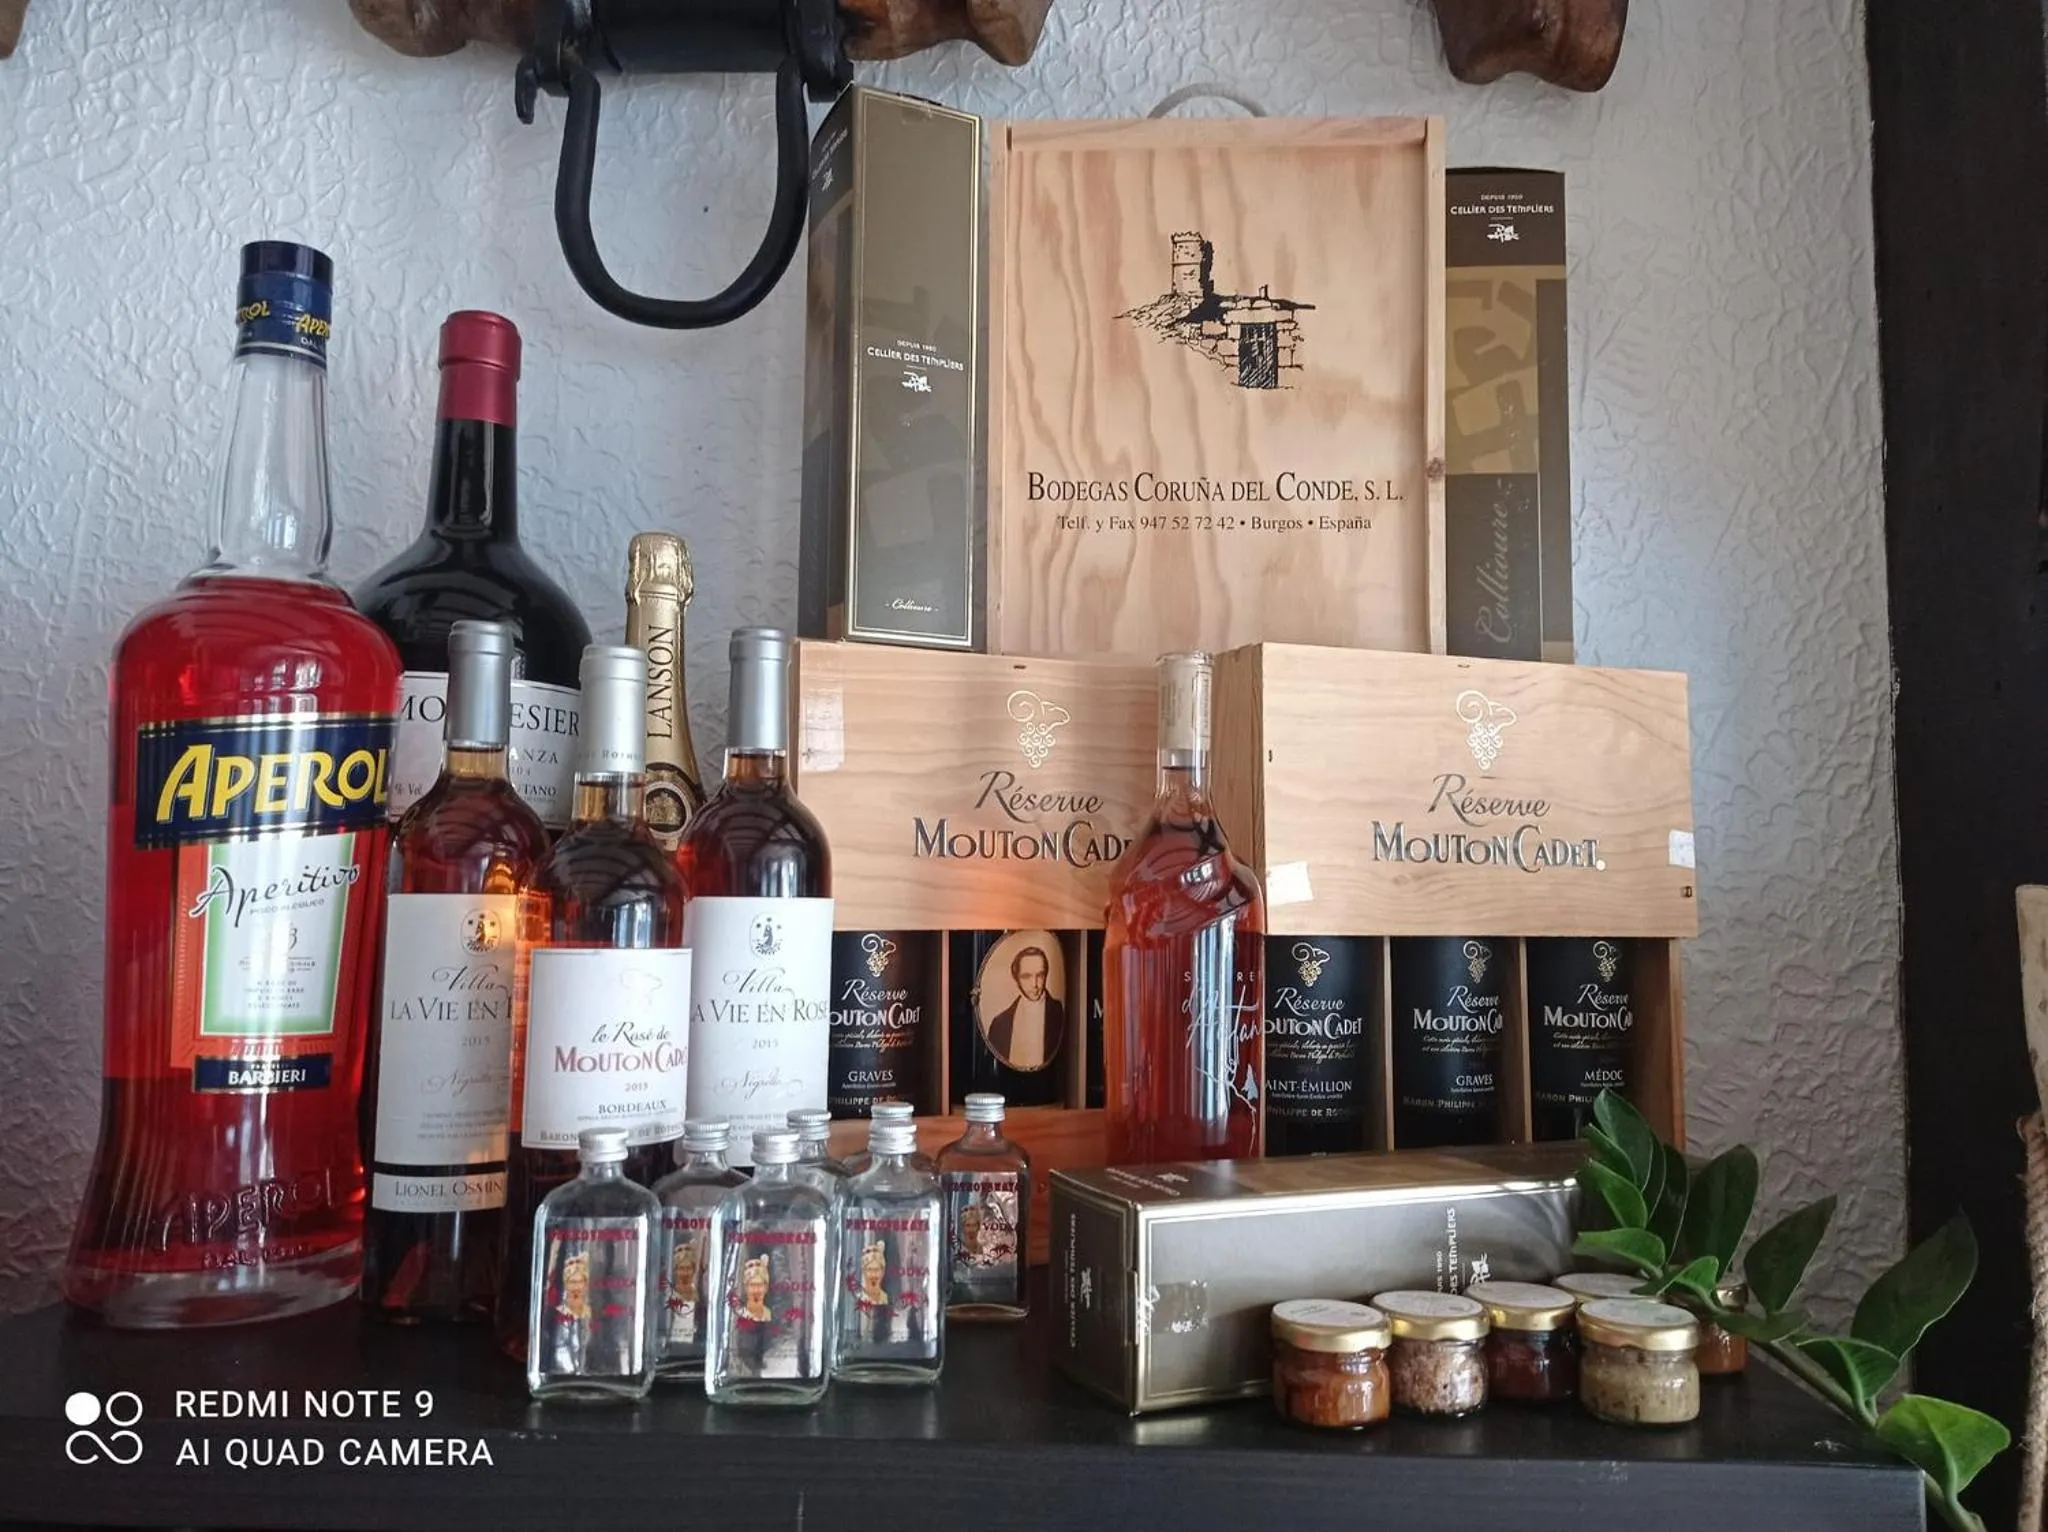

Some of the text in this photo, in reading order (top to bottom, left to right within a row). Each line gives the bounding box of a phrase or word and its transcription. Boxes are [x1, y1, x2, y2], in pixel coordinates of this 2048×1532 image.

[1450, 202, 1555, 215] CELLIER DES TEMPLIERS
[867, 346, 964, 372] CELLIER DES TEMPLIERS
[1028, 471, 1129, 502] BODEGAS
[1134, 471, 1225, 502] CORUÑA
[1231, 480, 1270, 501] DEL
[1095, 518, 1104, 534] y
[1109, 515, 1135, 530] Fax
[1140, 515, 1167, 530] 947
[1172, 515, 1189, 530] 52
[1196, 515, 1212, 530] 72
[1216, 515, 1235, 530] 42
[1251, 515, 1303, 533] Burgos
[1319, 515, 1372, 533] España
[646, 625, 674, 740] LANSON
[974, 770, 1104, 824] Réserve
[1428, 773, 1551, 827] Réserve
[912, 816, 1059, 860] MOUTON
[1371, 820, 1510, 865] MOUTON
[188, 863, 361, 928] Aperitivo
[841, 978, 908, 1008] Réserve
[1274, 986, 1346, 1017] Réserve
[390, 996, 499, 1021] LA VIE EN
[710, 998, 750, 1024] VIE
[888, 1002, 921, 1029] CADET
[1413, 1007, 1487, 1032] MOUTON
[1543, 1004, 1616, 1028] MOUTON
[1324, 1012, 1363, 1040] CADET
[554, 1045, 653, 1073] MOUTON
[228, 1068, 307, 1086] BARBIERI
[848, 1070, 894, 1082] GRAVES
[1456, 1073, 1493, 1087] GRAVES
[1584, 1067, 1624, 1081] MÉDOC
[598, 1099, 667, 1115] BORDEAUX
[395, 1180, 444, 1197] LIONEL
[1446, 1206, 1458, 1273] TEMPLIERS
